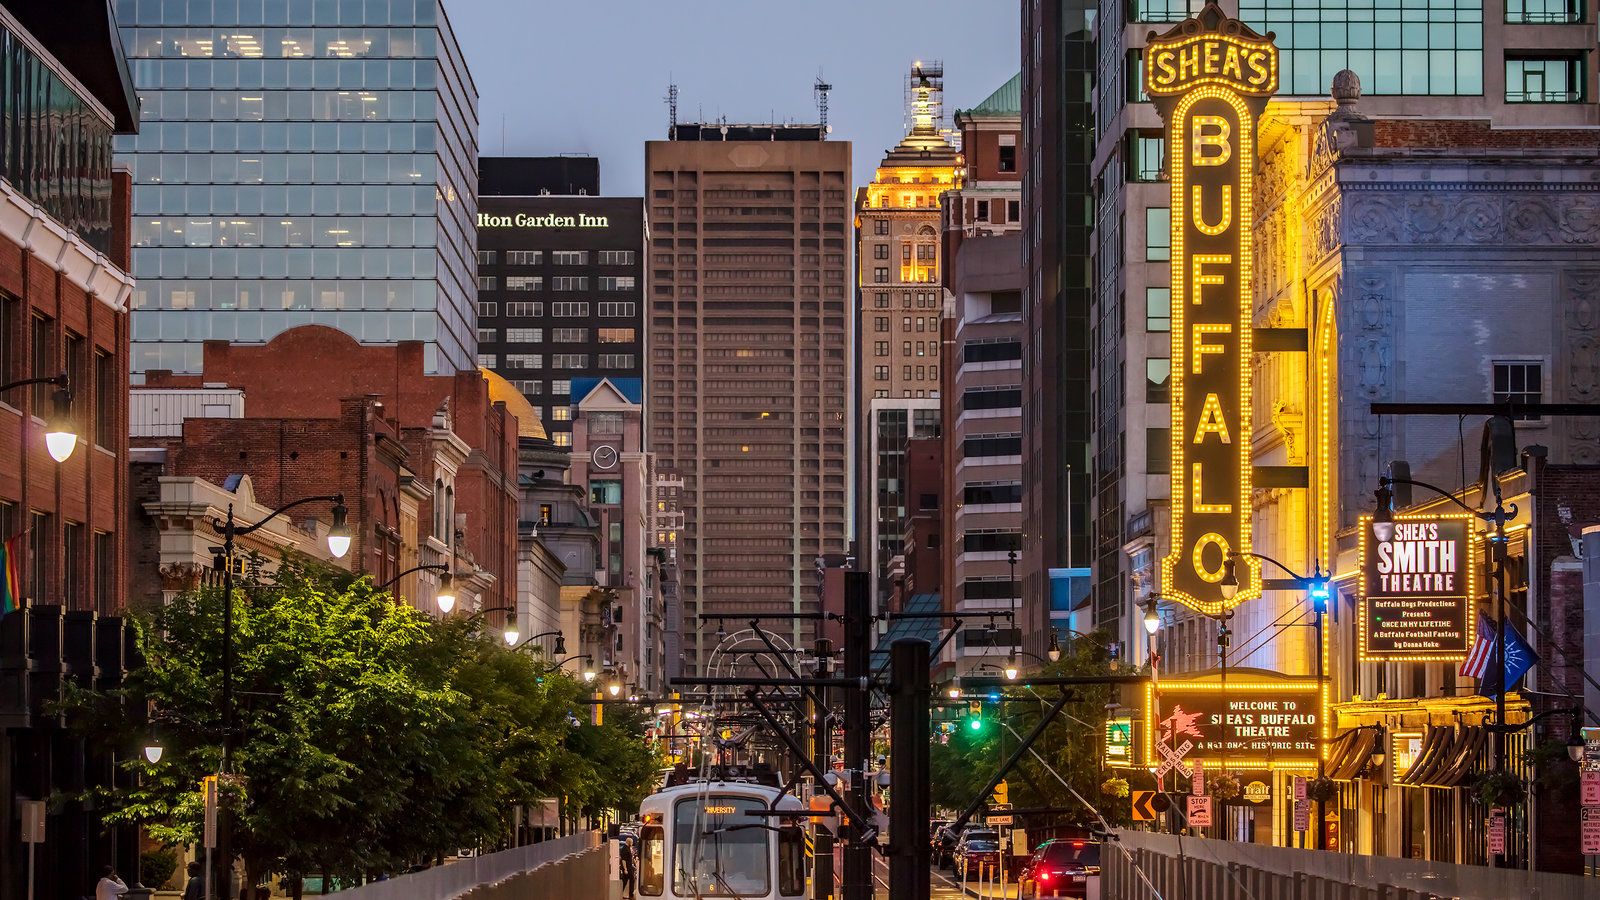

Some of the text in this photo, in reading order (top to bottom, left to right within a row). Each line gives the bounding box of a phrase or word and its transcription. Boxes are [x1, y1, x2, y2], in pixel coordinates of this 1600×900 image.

[1156, 42, 1268, 84] SHEA'S
[515, 213, 576, 227] Garden
[578, 213, 608, 227] Inn
[1192, 115, 1232, 584] BUFFALO
[1394, 523, 1438, 540] SHEA'S
[1377, 540, 1456, 573] SMITH
[1380, 574, 1454, 592] THEATRE
[1229, 702, 1296, 710] WELCOME TO
[1261, 714, 1316, 725] BUFFALO
[1235, 726, 1290, 736] THEATRE
[1157, 741, 1191, 777] RAIL ROAD
[1158, 742, 1190, 775] CROSSING
[1583, 810, 1588, 819] 2
